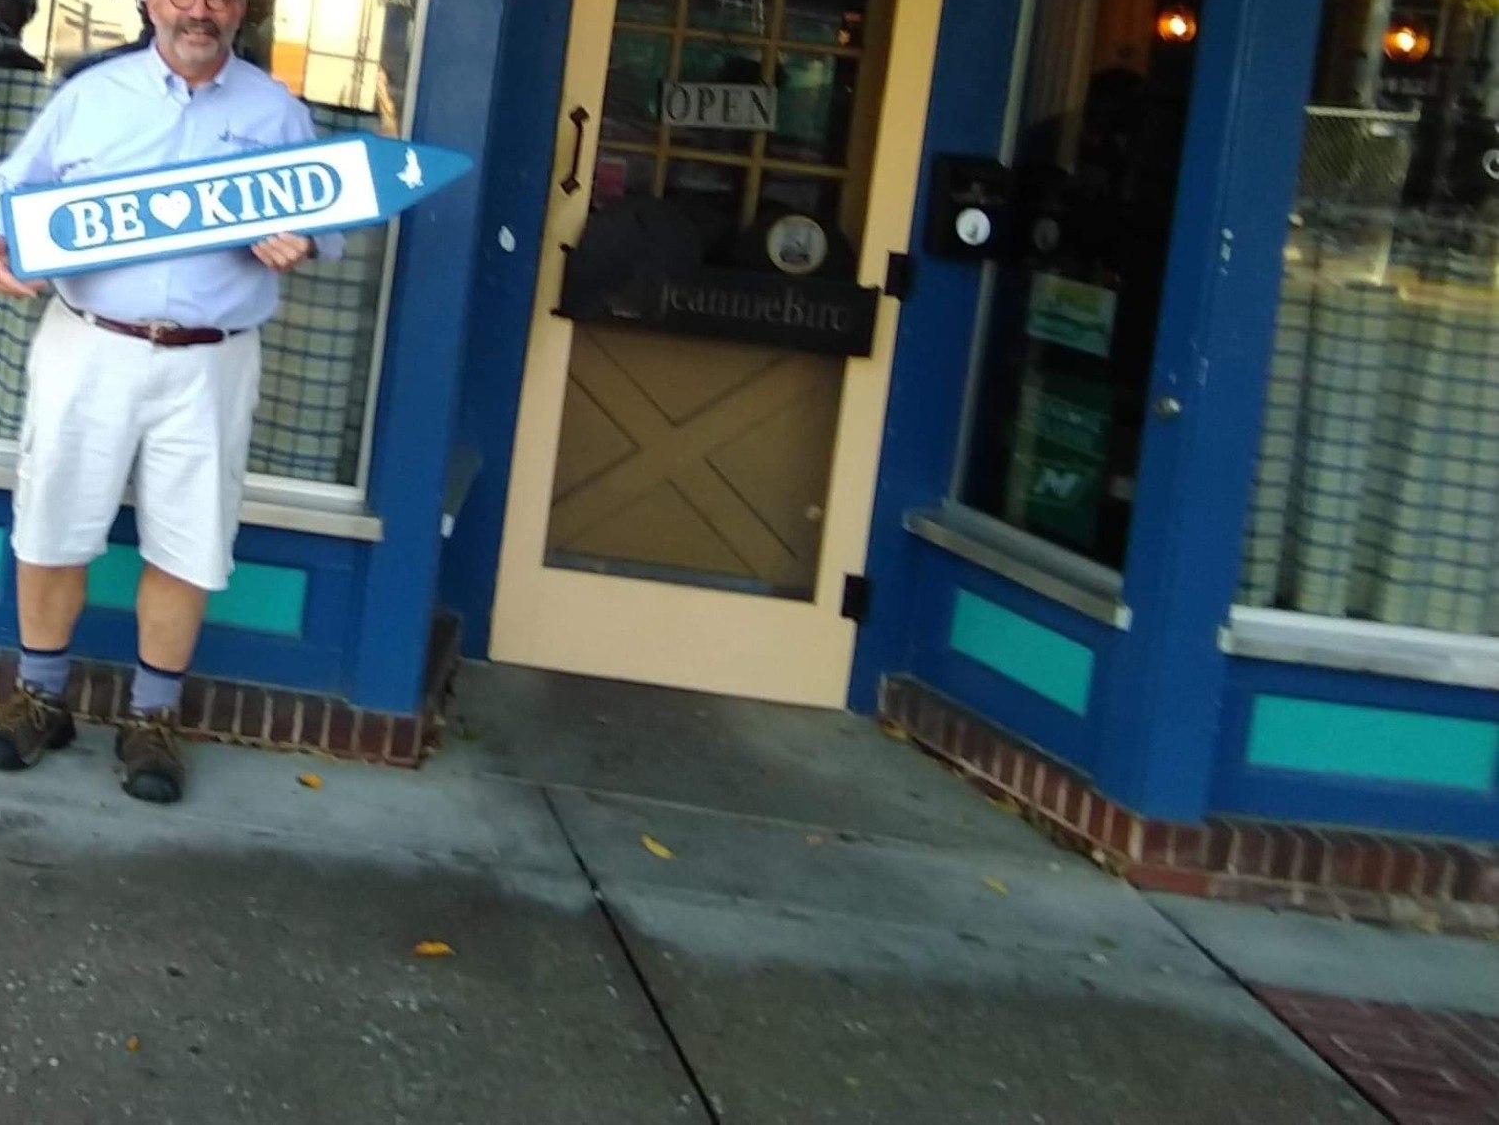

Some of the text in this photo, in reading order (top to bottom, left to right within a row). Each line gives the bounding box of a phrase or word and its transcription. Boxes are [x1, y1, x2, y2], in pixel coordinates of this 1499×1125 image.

[666, 84, 771, 125] OPEN
[66, 164, 336, 248] BE KIND
